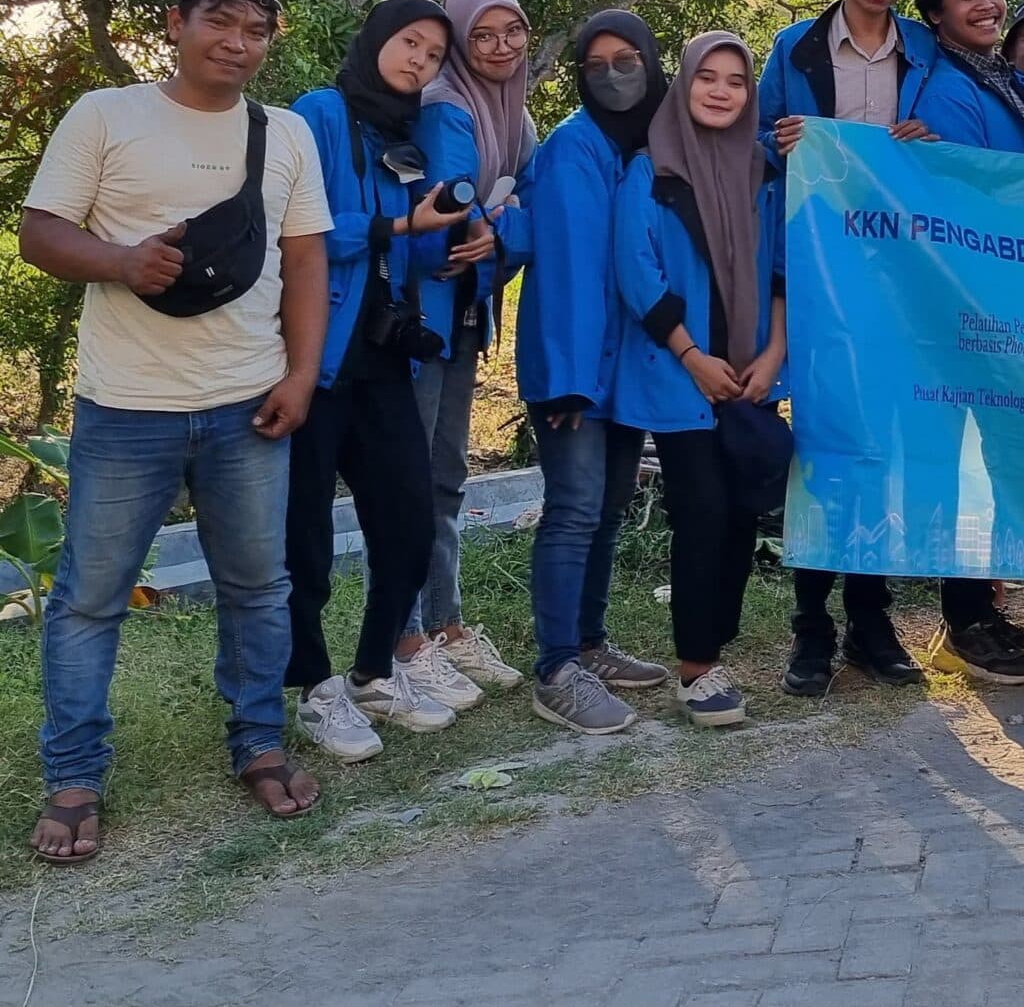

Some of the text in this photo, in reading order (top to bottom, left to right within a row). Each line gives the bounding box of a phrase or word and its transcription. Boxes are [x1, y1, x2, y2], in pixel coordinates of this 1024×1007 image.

[844, 209, 899, 239] KKN
[958, 333, 1001, 353] berbasis
[913, 384, 939, 401] Pusat
[942, 385, 974, 408] Kajian
